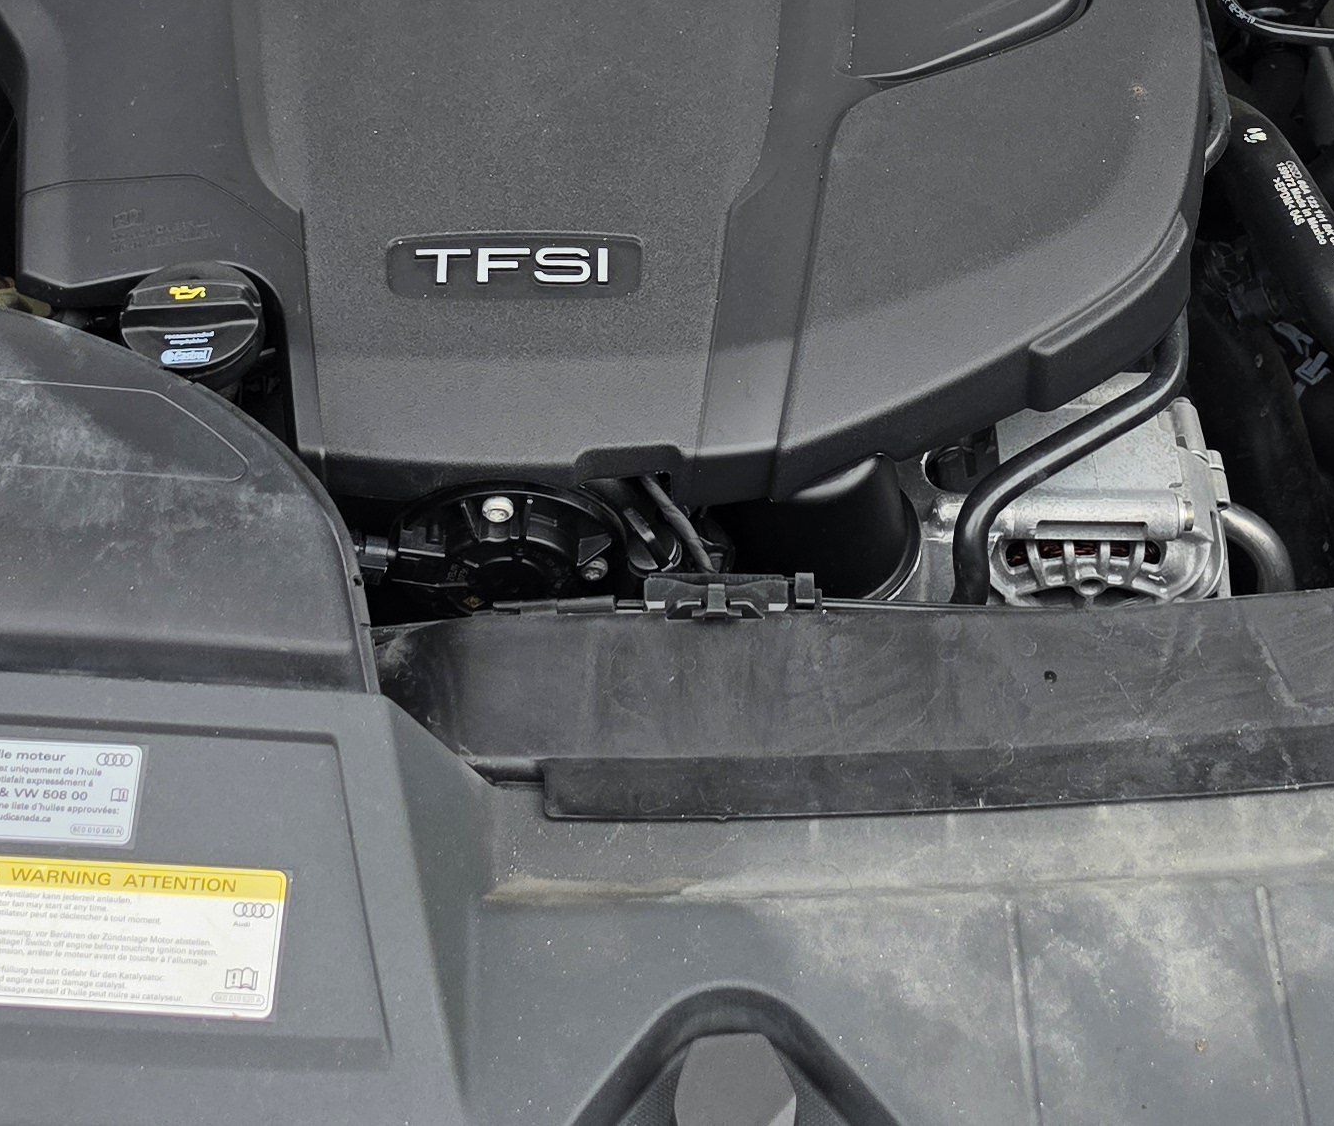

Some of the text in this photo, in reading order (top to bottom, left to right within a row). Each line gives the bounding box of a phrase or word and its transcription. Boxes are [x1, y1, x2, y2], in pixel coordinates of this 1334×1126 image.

[415, 248, 609, 284] TFSI
[16, 751, 65, 761] moteur
[10, 764, 60, 775] uniquement
[76, 767, 101, 775] l'huile
[14, 788, 38, 798] VW
[42, 789, 67, 799] 508
[71, 791, 87, 800] 00
[11, 801, 28, 809] liste
[31, 802, 65, 811] d'huiles
[66, 804, 119, 815] approuvées:
[10, 867, 111, 886] WARNING
[122, 873, 236, 892] ATTENTION
